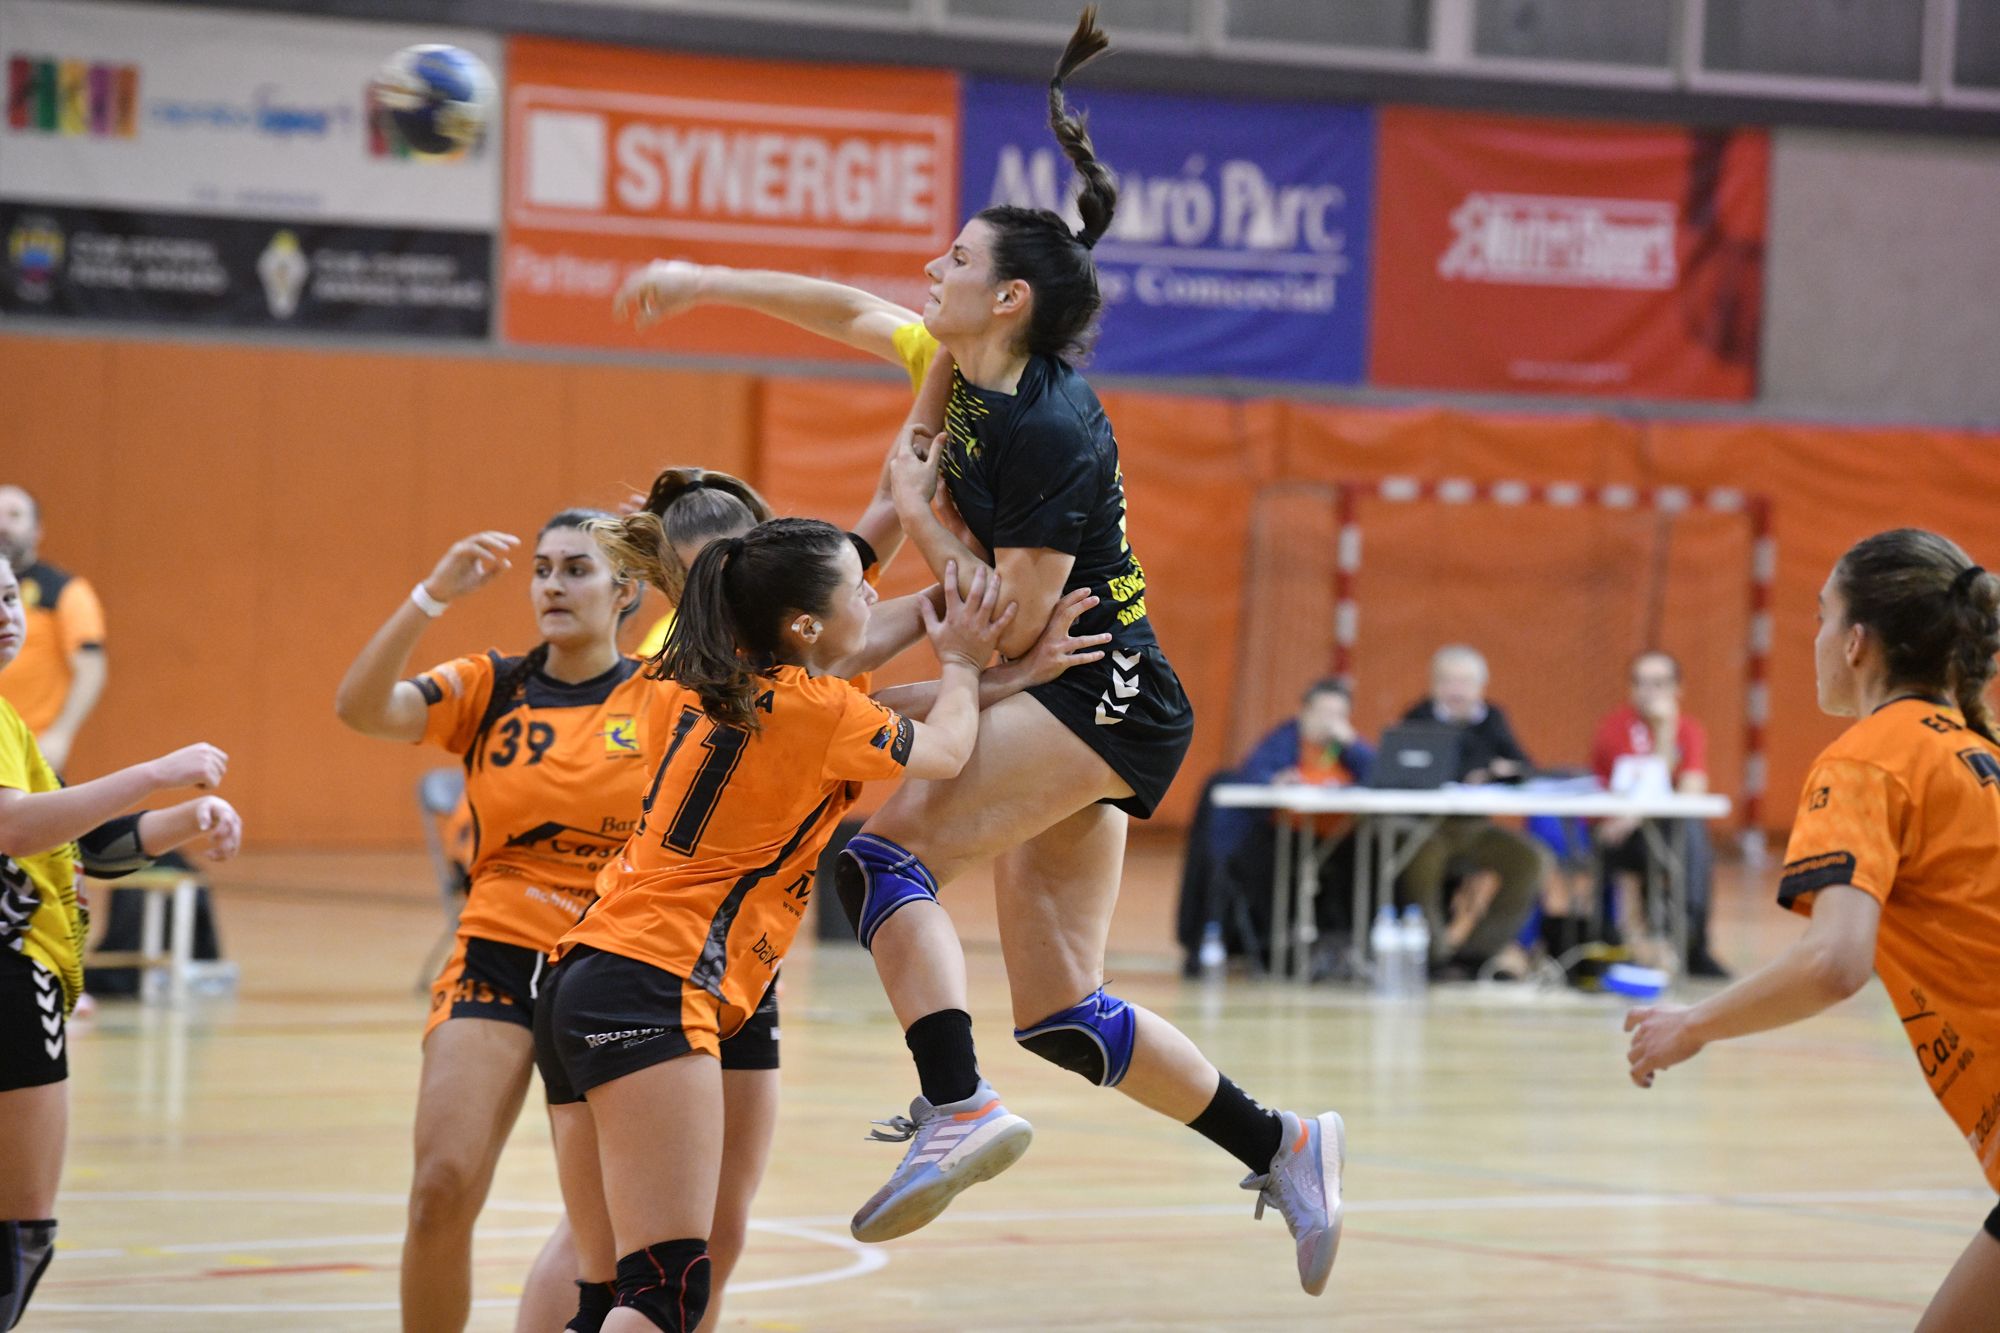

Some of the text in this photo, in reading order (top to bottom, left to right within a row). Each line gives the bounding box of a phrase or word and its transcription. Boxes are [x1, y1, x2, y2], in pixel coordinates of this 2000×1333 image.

[615, 124, 934, 226] SYNERGIE
[1219, 158, 1346, 254] Parc
[1135, 264, 1336, 314] Comercial
[490, 717, 556, 768] 39
